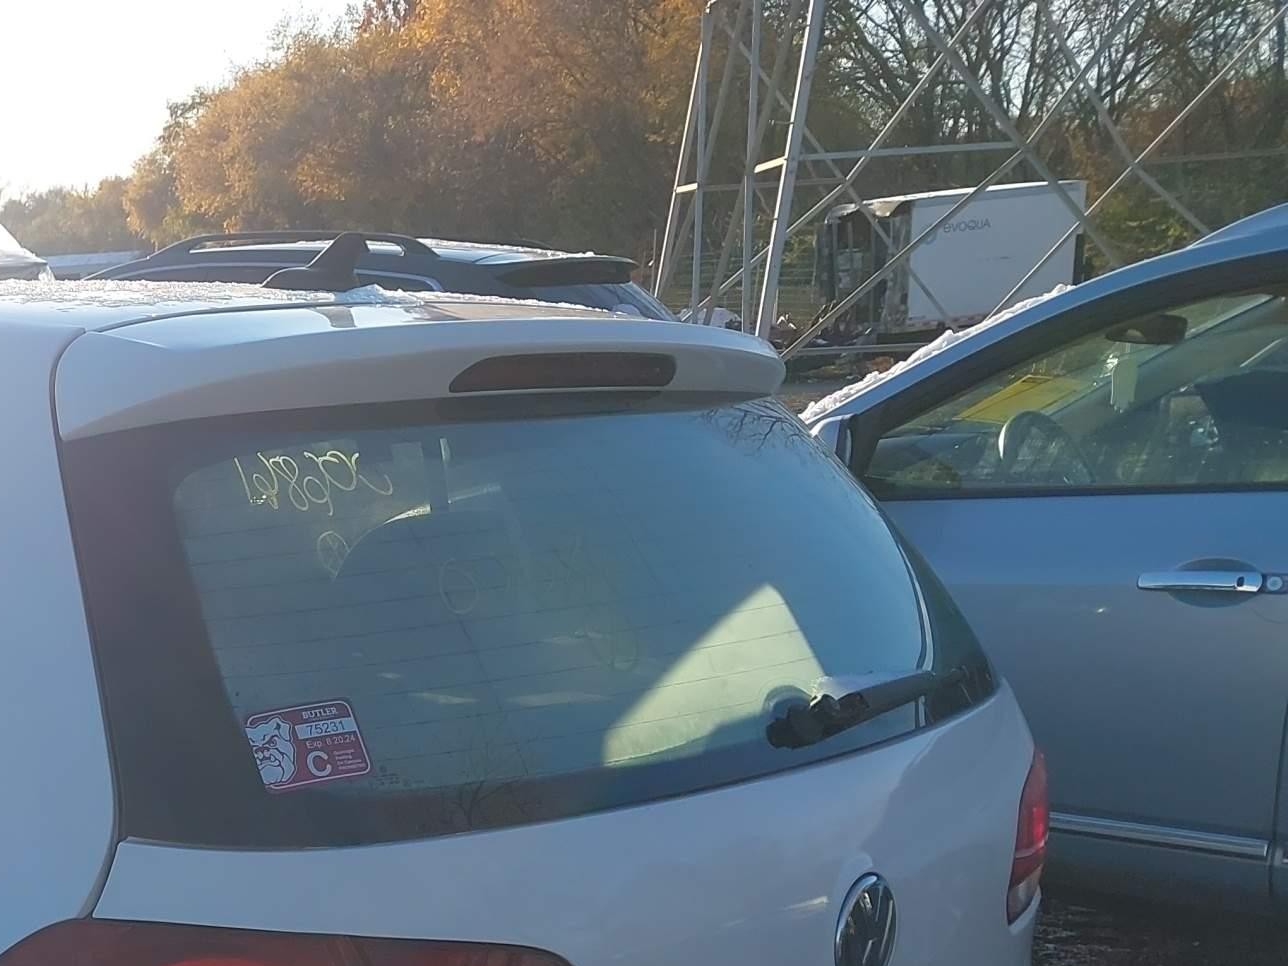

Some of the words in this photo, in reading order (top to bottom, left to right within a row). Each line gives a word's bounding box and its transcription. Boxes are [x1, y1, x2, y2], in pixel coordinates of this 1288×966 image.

[302, 708, 338, 719] BUTLER
[306, 720, 345, 736] 75231
[307, 751, 332, 777] C
